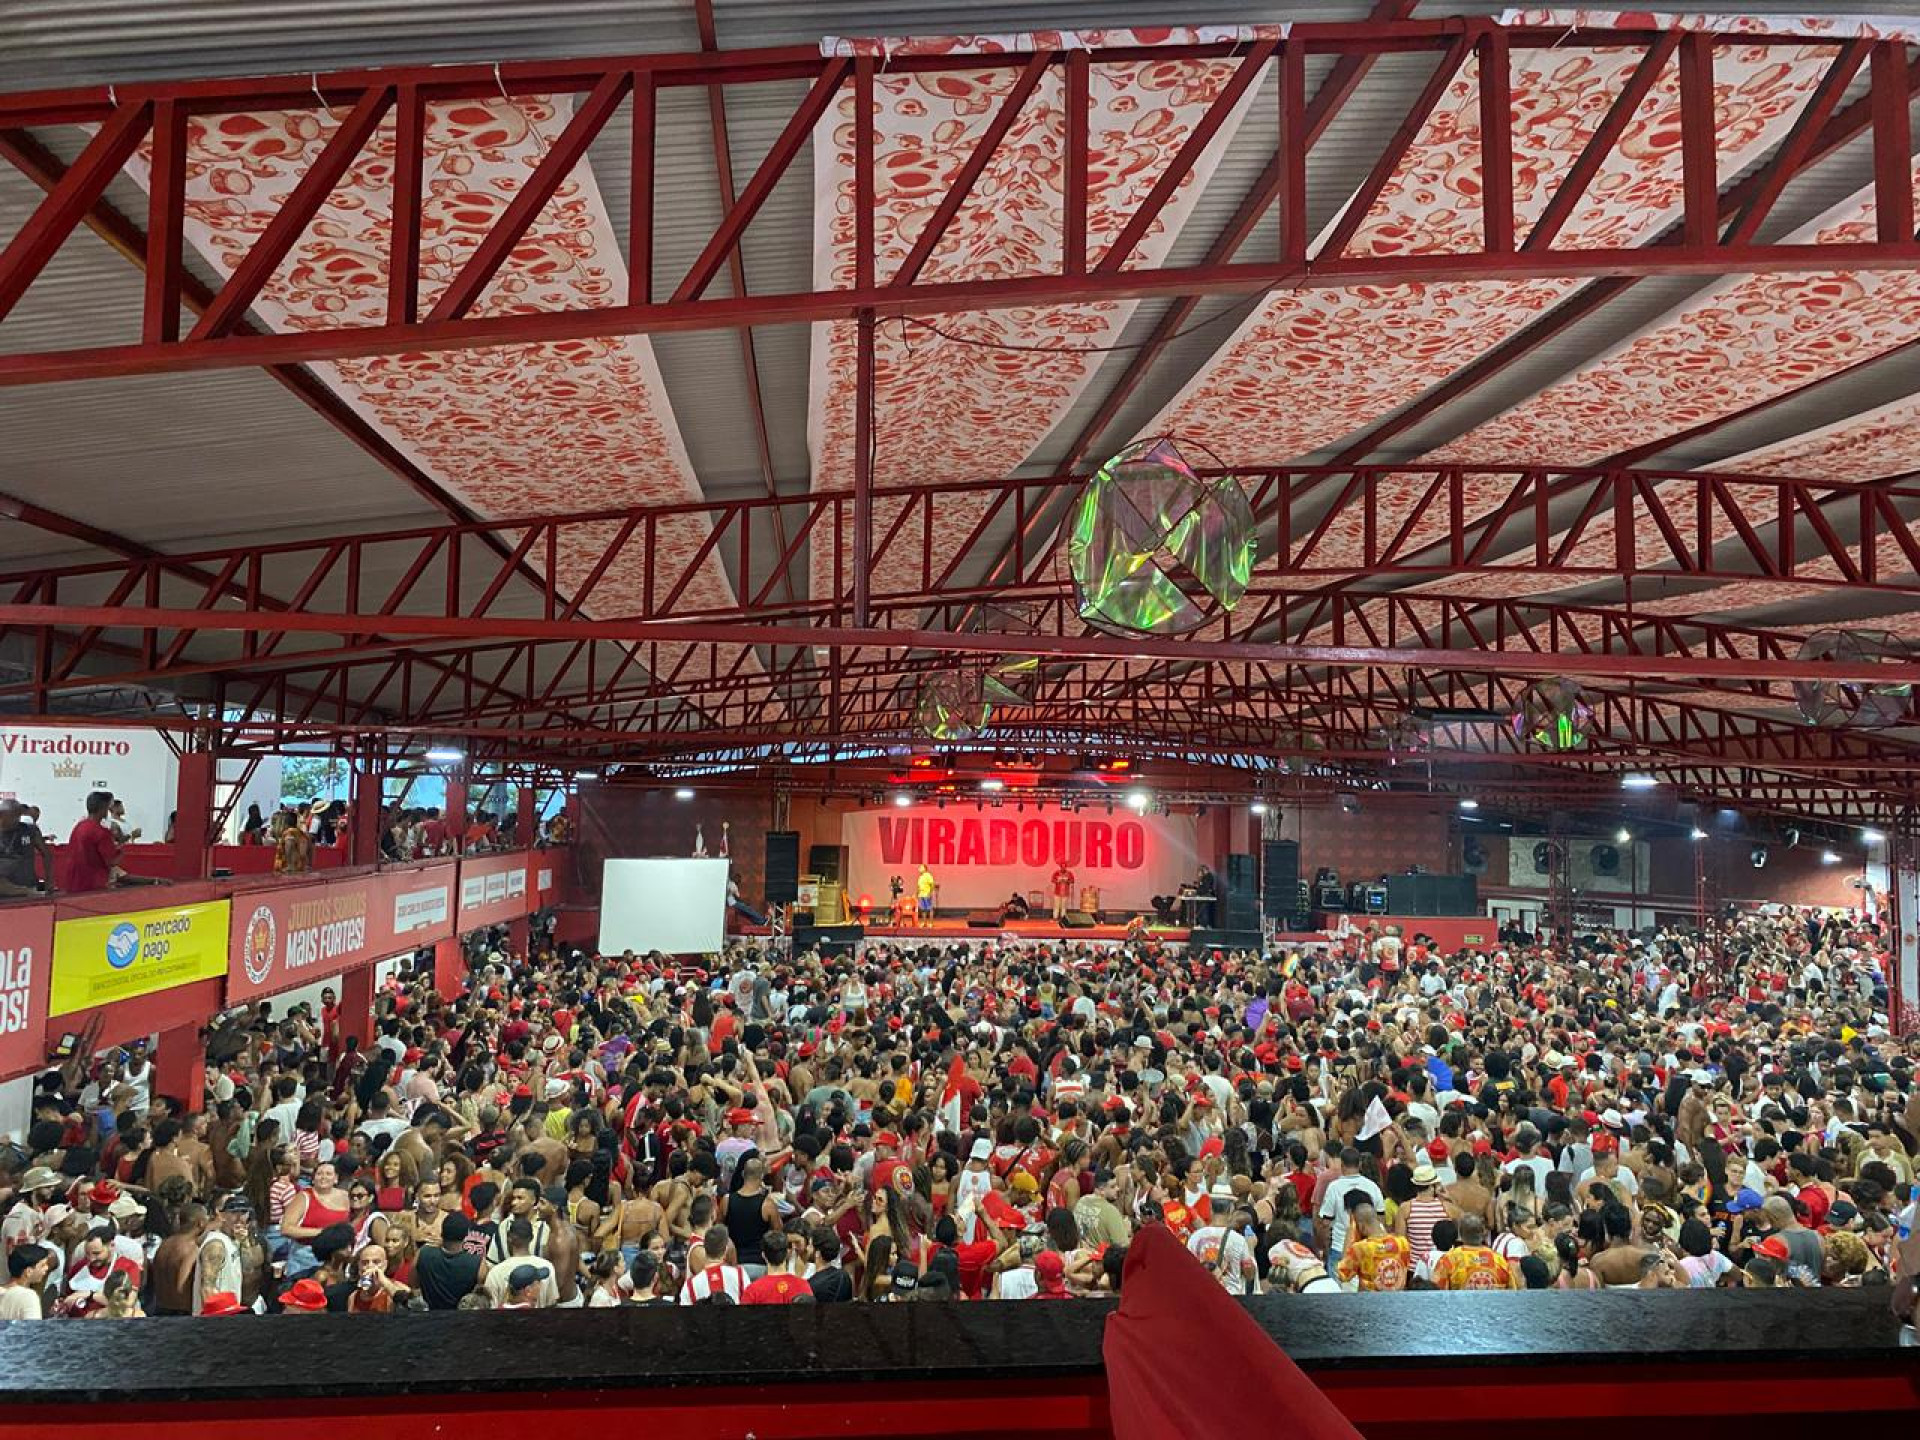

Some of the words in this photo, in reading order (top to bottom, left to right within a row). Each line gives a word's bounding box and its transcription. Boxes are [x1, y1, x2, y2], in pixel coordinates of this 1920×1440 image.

[1, 733, 131, 756] Viradouro
[878, 817, 1145, 869] VIRADOURO
[143, 914, 191, 938] mercado
[142, 940, 169, 963] pago
